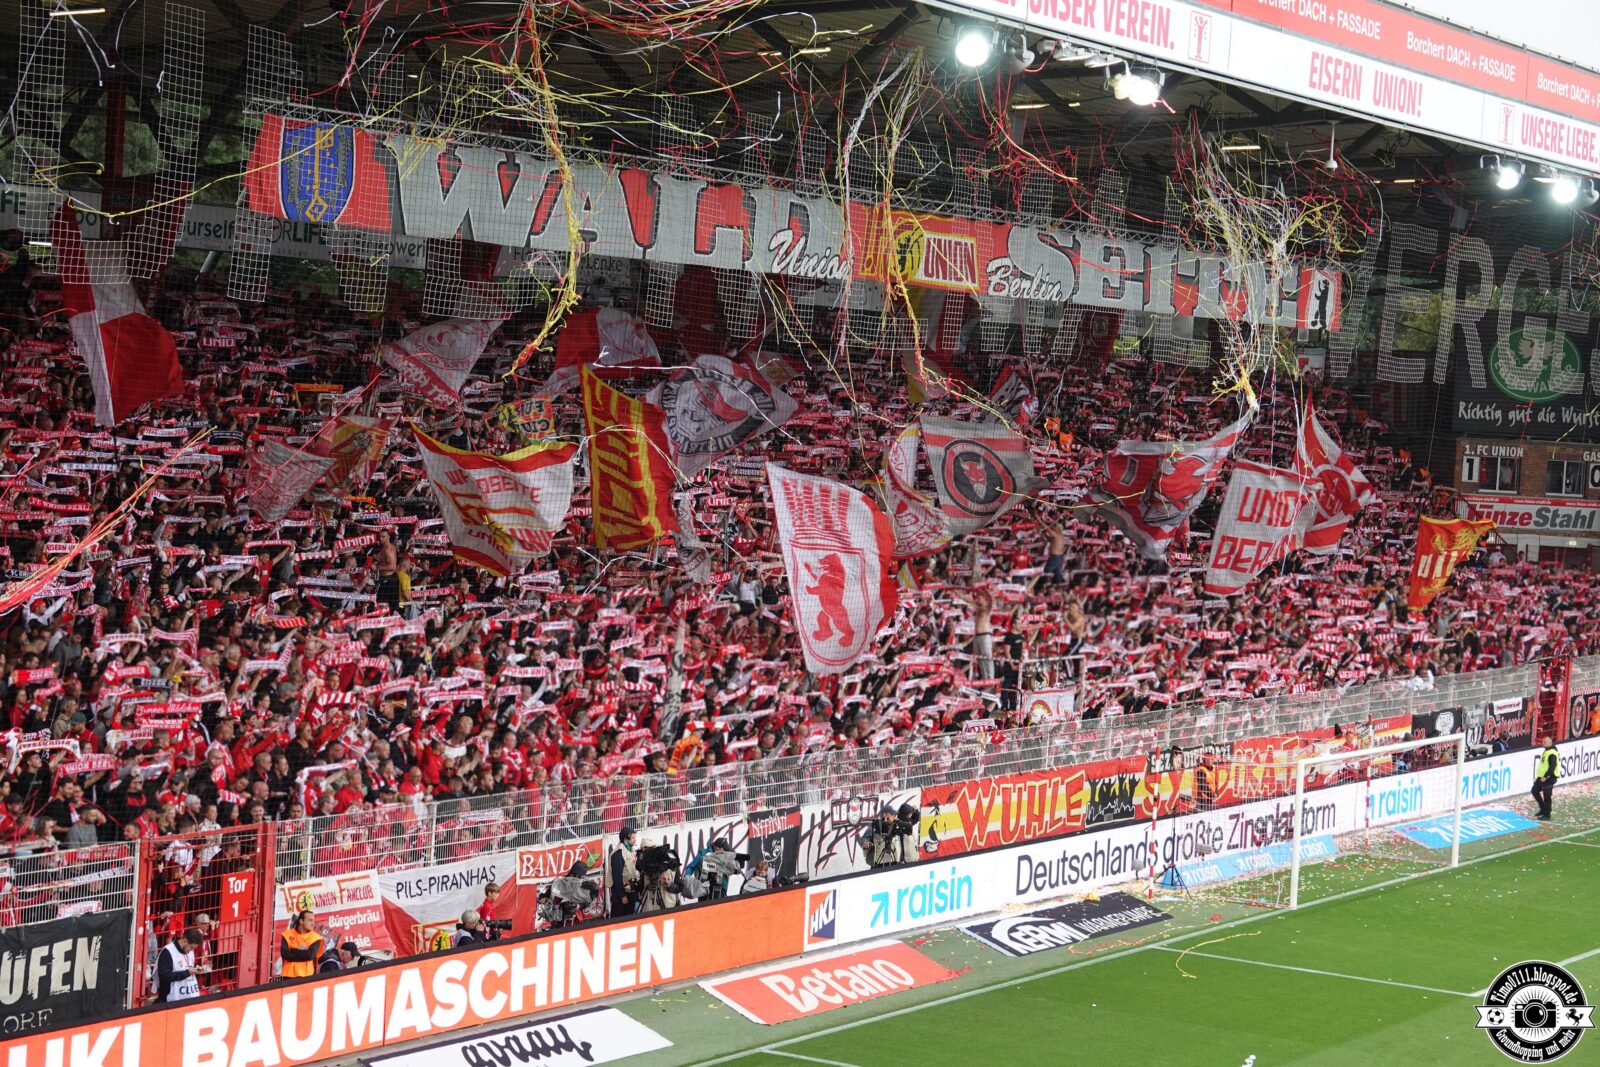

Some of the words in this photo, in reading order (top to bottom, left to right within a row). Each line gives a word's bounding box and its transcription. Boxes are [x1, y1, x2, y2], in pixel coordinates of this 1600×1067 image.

[1104, 2, 1175, 51] VEREIN.
[1257, 0, 1297, 16] rchert
[1298, 1, 1327, 24] DACH
[1337, 12, 1381, 40] FASSADE
[1407, 31, 1445, 61] Borchert
[1446, 43, 1470, 68] DACH
[1479, 55, 1516, 83] FASSADE
[1309, 51, 1363, 101] EISERN
[1373, 70, 1423, 118] UNION!
[1537, 72, 1569, 99] Borchert
[1569, 81, 1590, 105] DACH
[1521, 112, 1564, 154] UNSERE
[1566, 125, 1598, 164] LIEBE.
[769, 230, 854, 281] Union
[924, 239, 976, 282] UNION
[986, 257, 1064, 302] Berlin
[1458, 401, 1502, 425] Richtig
[1508, 407, 1533, 427] gut
[1538, 405, 1556, 424] die
[1562, 405, 1600, 428] Wurst
[1464, 444, 1476, 456] 1.
[1477, 445, 1488, 456] FC
[1492, 446, 1524, 458] UNION
[1466, 458, 1475, 481] 1
[338, 535, 376, 550] UNION
[1472, 763, 1512, 799] raisin
[1533, 746, 1600, 782] tschlan
[956, 769, 1087, 851] WUHLE
[1378, 777, 1424, 818] raisin
[1015, 829, 1159, 896] Deutschlands
[1164, 819, 1223, 864] größte
[1227, 802, 1336, 851] Zinsplatform
[228, 877, 248, 894] Tor
[313, 891, 338, 908] UNION
[396, 865, 496, 900] PILS-PIRANHAS
[897, 866, 973, 923] raisin
[231, 901, 239, 918] 1
[329, 910, 380, 931] Bürgerbräu
[810, 890, 836, 938] HKL
[1009, 921, 1090, 955] KERMI
[182, 919, 675, 1067] BAUMASCHINEN
[759, 957, 916, 1013] Betano
